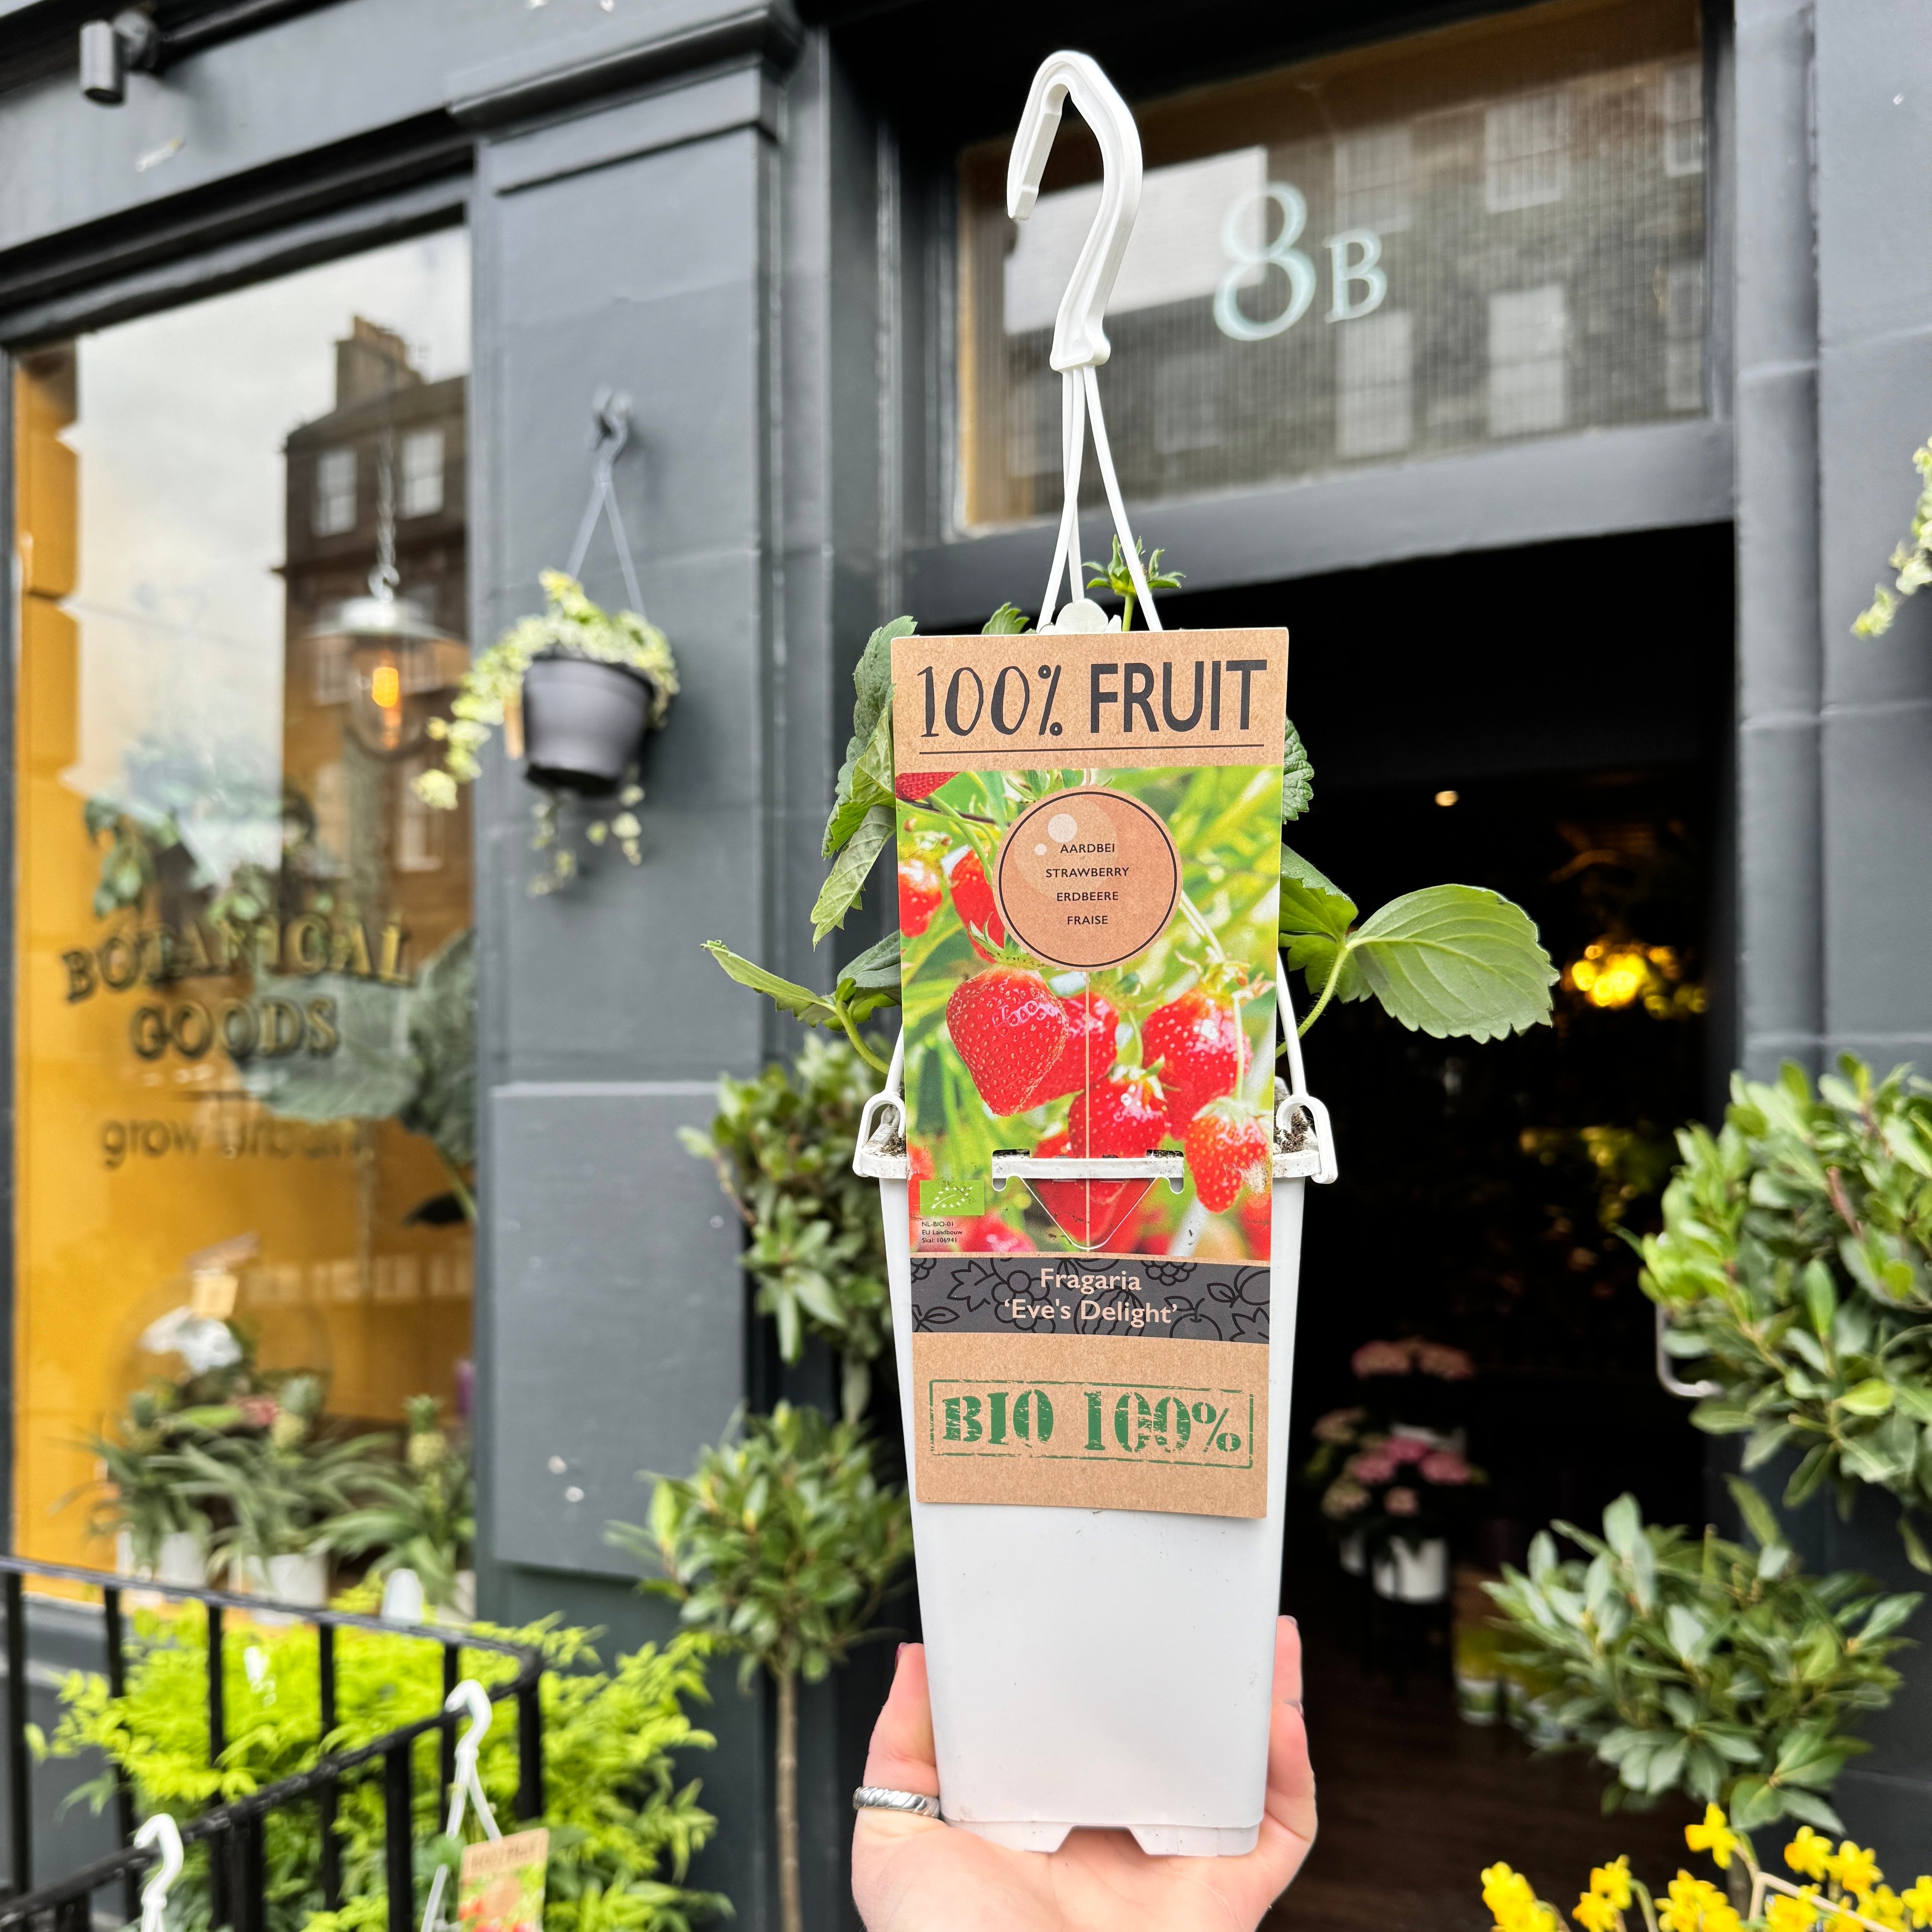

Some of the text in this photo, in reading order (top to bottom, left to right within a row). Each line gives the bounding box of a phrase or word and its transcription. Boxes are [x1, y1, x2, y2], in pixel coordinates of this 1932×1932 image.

[917, 659, 1268, 737] 100% FRUIT
[1060, 843, 1115, 853] AARDBEI
[1046, 867, 1130, 878] STRAWBERRY
[1057, 891, 1119, 902] ERDBEERE
[1067, 915, 1109, 925] FRAISE
[129, 994, 340, 1061] GOODS
[100, 1118, 199, 1170] grow
[1040, 1268, 1142, 1295] Fragaria
[942, 1389, 1242, 1454] BIO 100%
